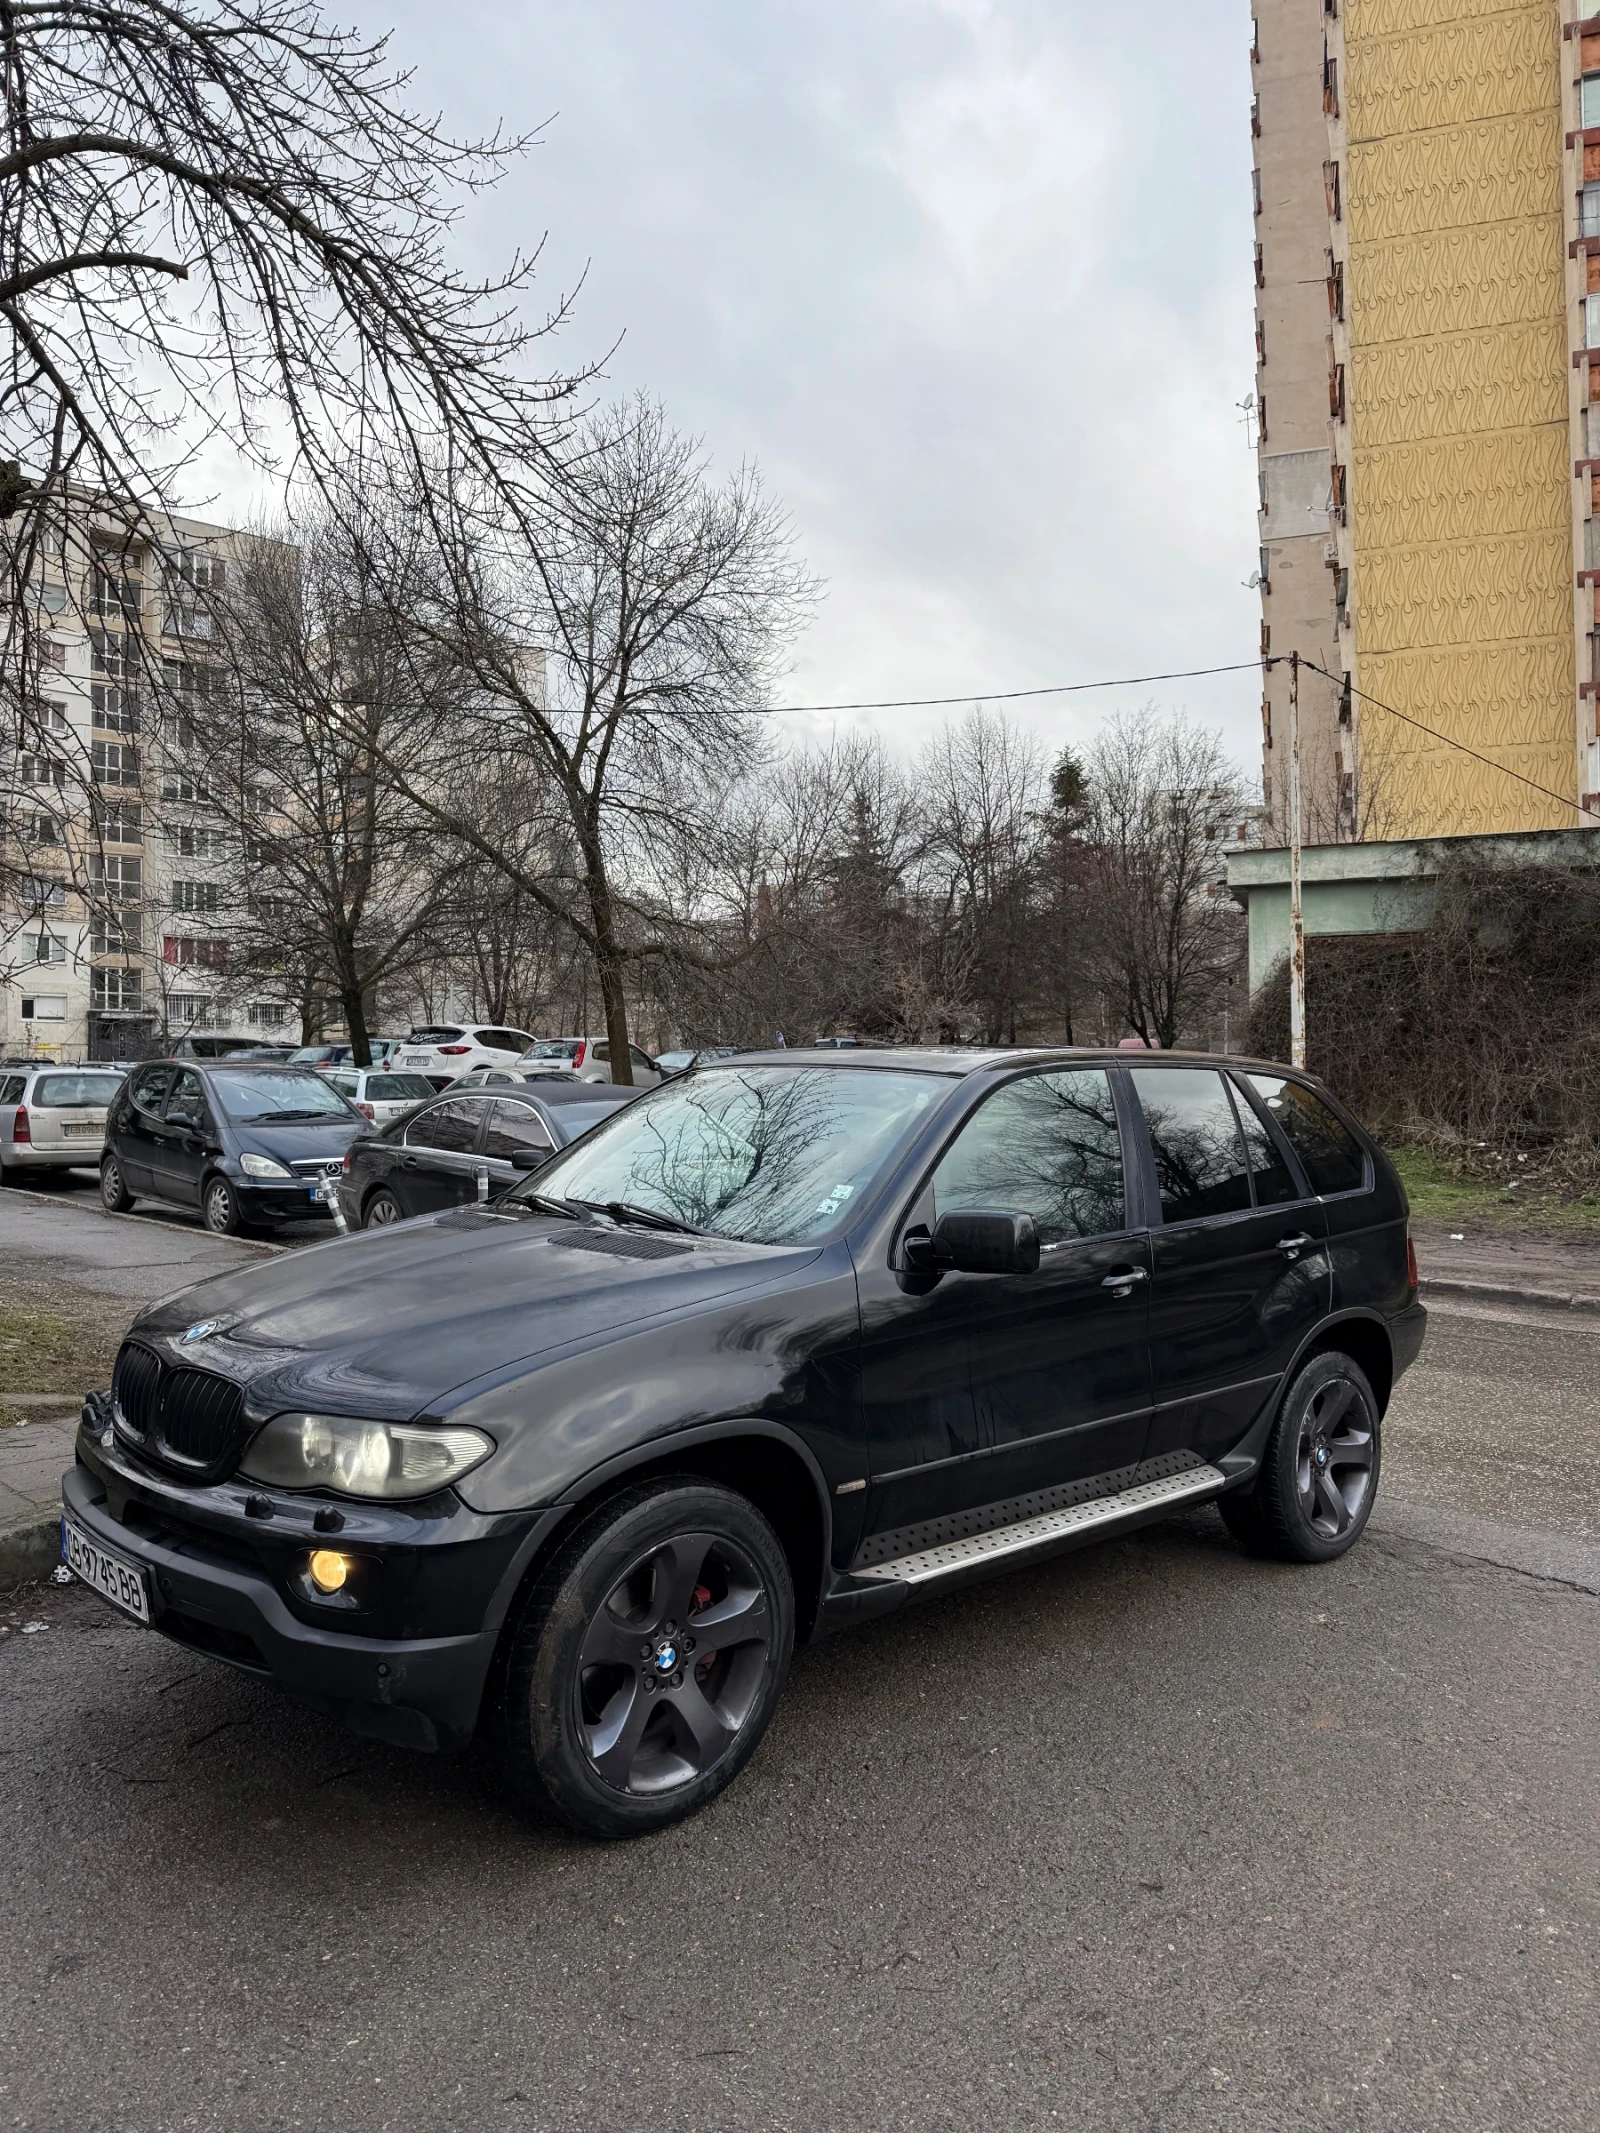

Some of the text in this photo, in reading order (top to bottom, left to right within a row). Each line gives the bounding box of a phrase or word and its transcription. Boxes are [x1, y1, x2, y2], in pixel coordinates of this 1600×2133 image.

[67, 1528, 142, 1612] CB 9745 BB
